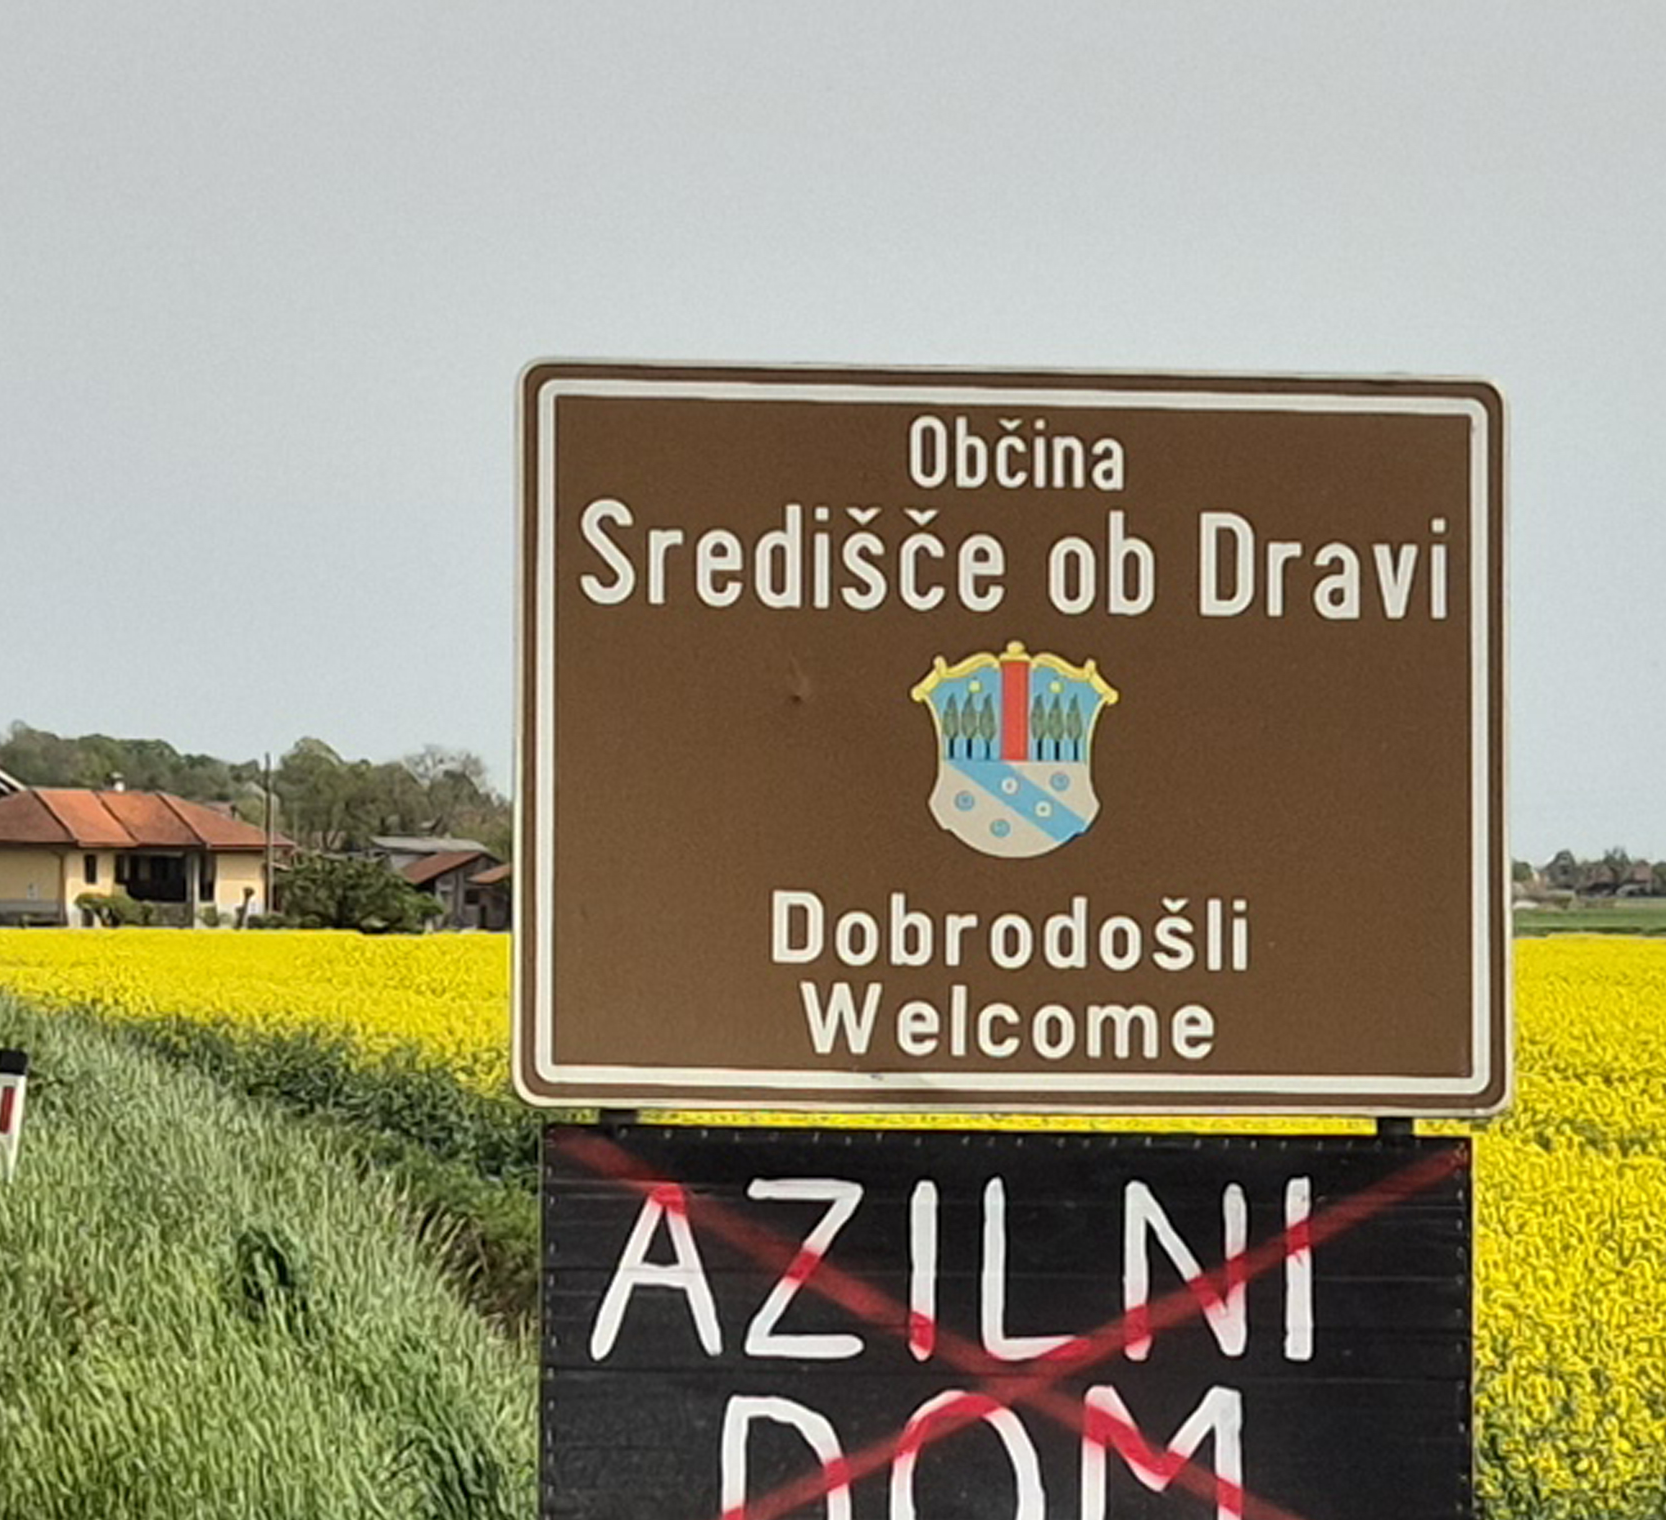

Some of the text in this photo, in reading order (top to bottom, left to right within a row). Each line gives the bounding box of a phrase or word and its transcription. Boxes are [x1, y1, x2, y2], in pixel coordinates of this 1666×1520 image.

[909, 415, 1124, 491] Občina
[580, 498, 1448, 620] Središče ob Dravi
[772, 890, 1249, 972] Dobrodošli
[800, 981, 1216, 1060] Welcome
[590, 1176, 1315, 1362] AZILNI
